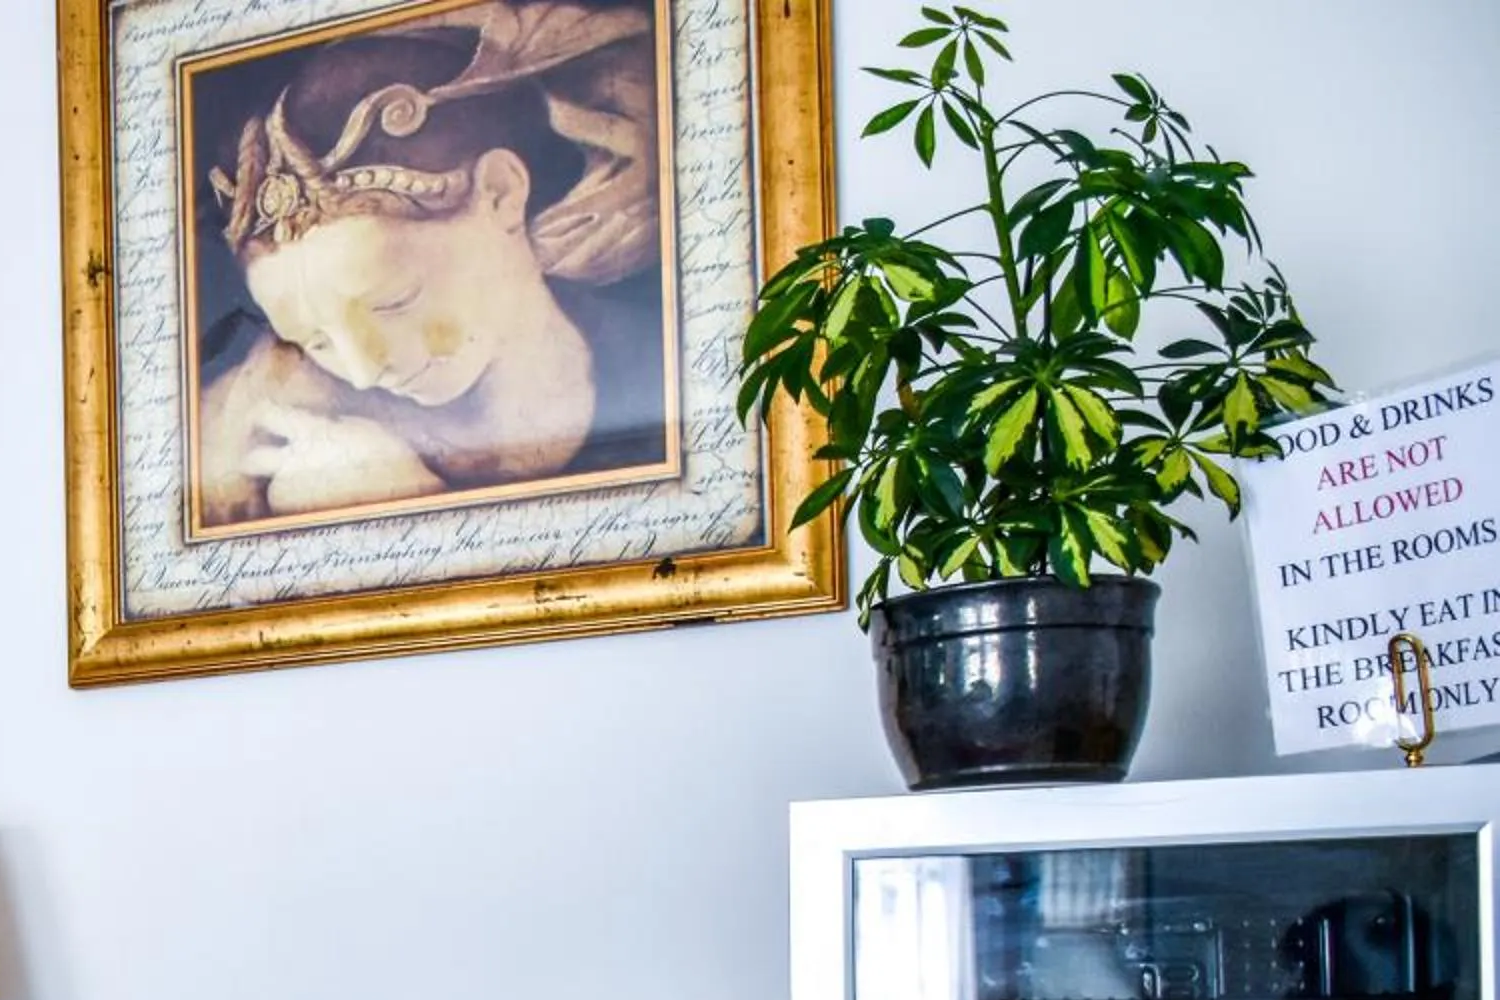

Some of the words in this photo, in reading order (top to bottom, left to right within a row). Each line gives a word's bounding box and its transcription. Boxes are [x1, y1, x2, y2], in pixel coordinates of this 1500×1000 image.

[1257, 422, 1341, 462] OOD
[1349, 413, 1373, 440] &
[1381, 377, 1495, 431] DRINKS
[1317, 455, 1379, 491] ARE
[1386, 435, 1448, 473] NOT
[1313, 477, 1464, 535] ALLOWED
[1278, 560, 1312, 588] IN
[1320, 545, 1385, 578] THE
[1391, 518, 1498, 565] ROOMS
[1286, 606, 1410, 651] KINDLY
[1419, 593, 1474, 627] EAT
[1278, 661, 1343, 693] THE
[1353, 631, 1500, 682] BREAKFAS
[1428, 677, 1500, 712] ONLY
